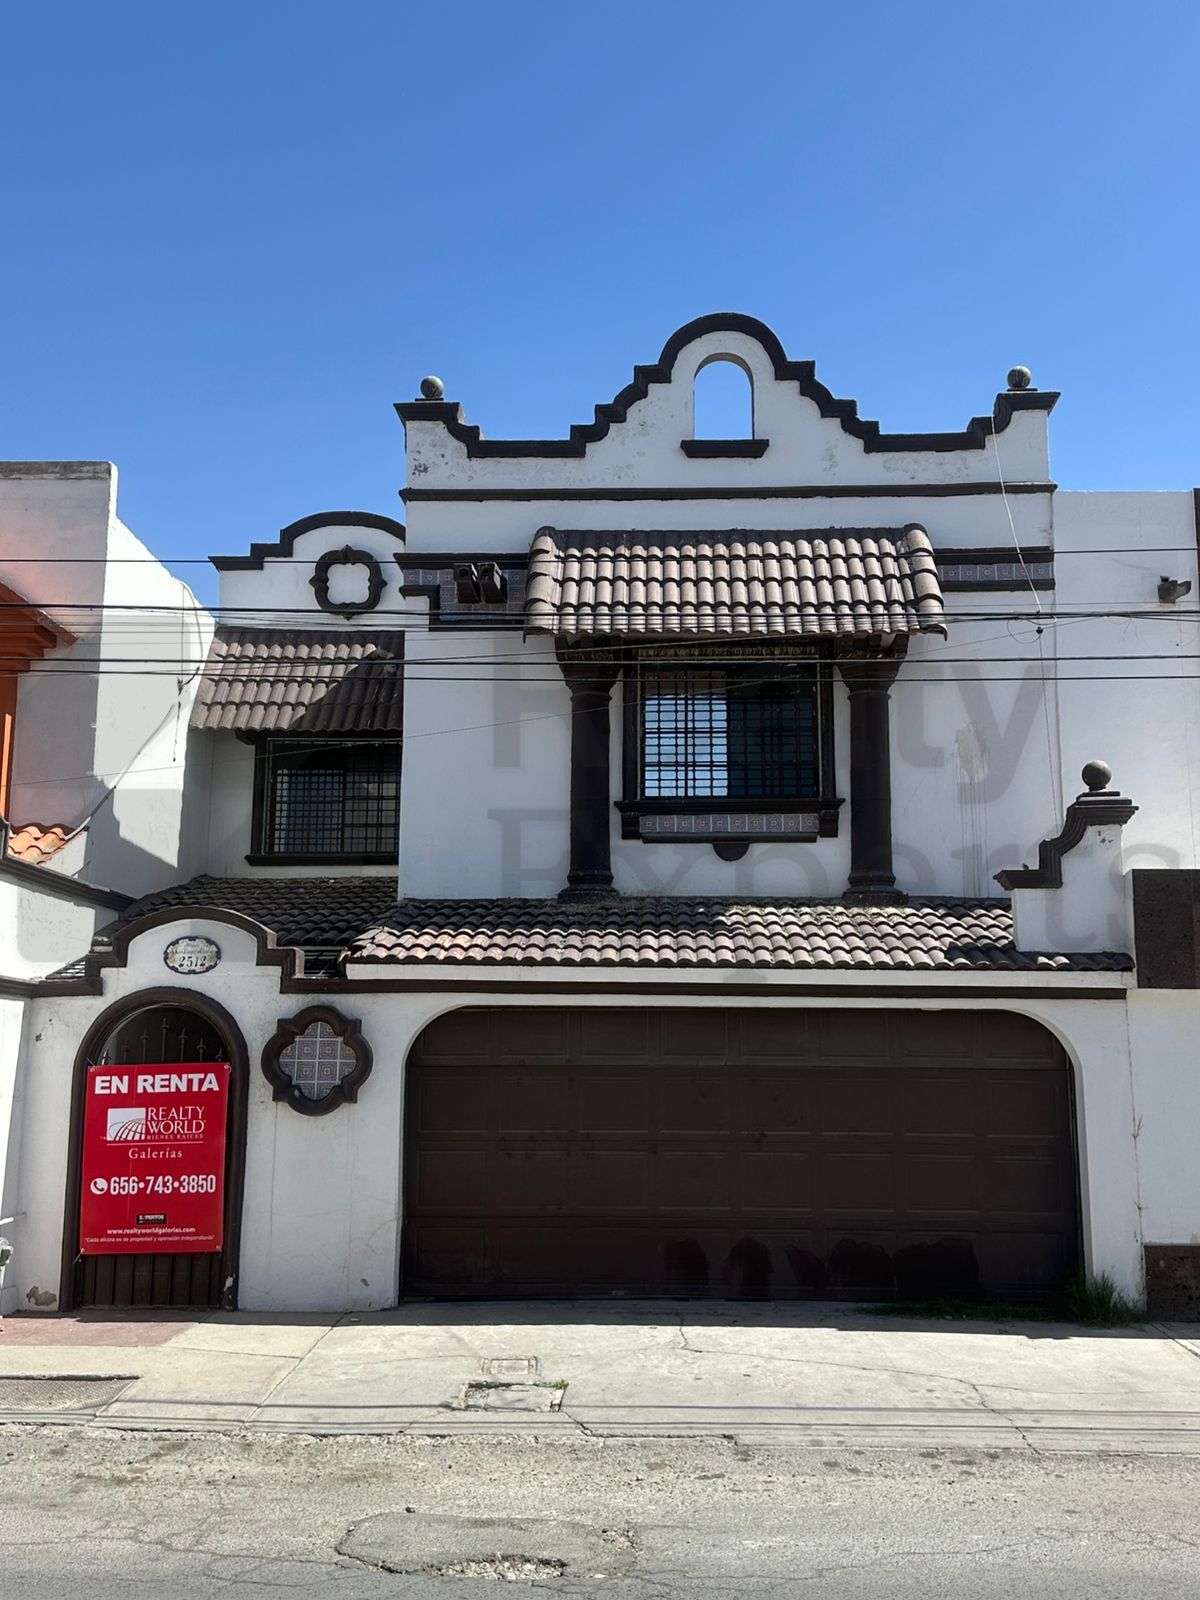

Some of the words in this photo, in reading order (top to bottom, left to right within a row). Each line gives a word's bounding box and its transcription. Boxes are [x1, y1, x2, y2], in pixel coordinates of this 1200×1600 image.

[178, 955, 207, 968] 2512
[95, 1075, 129, 1094] EN
[137, 1073, 219, 1093] RENTA
[147, 1106, 205, 1120] REALTY
[147, 1120, 205, 1134] WORLD
[128, 1147, 183, 1160] Galerías
[107, 1227, 196, 1235] www.realtyworldgalerias.com
